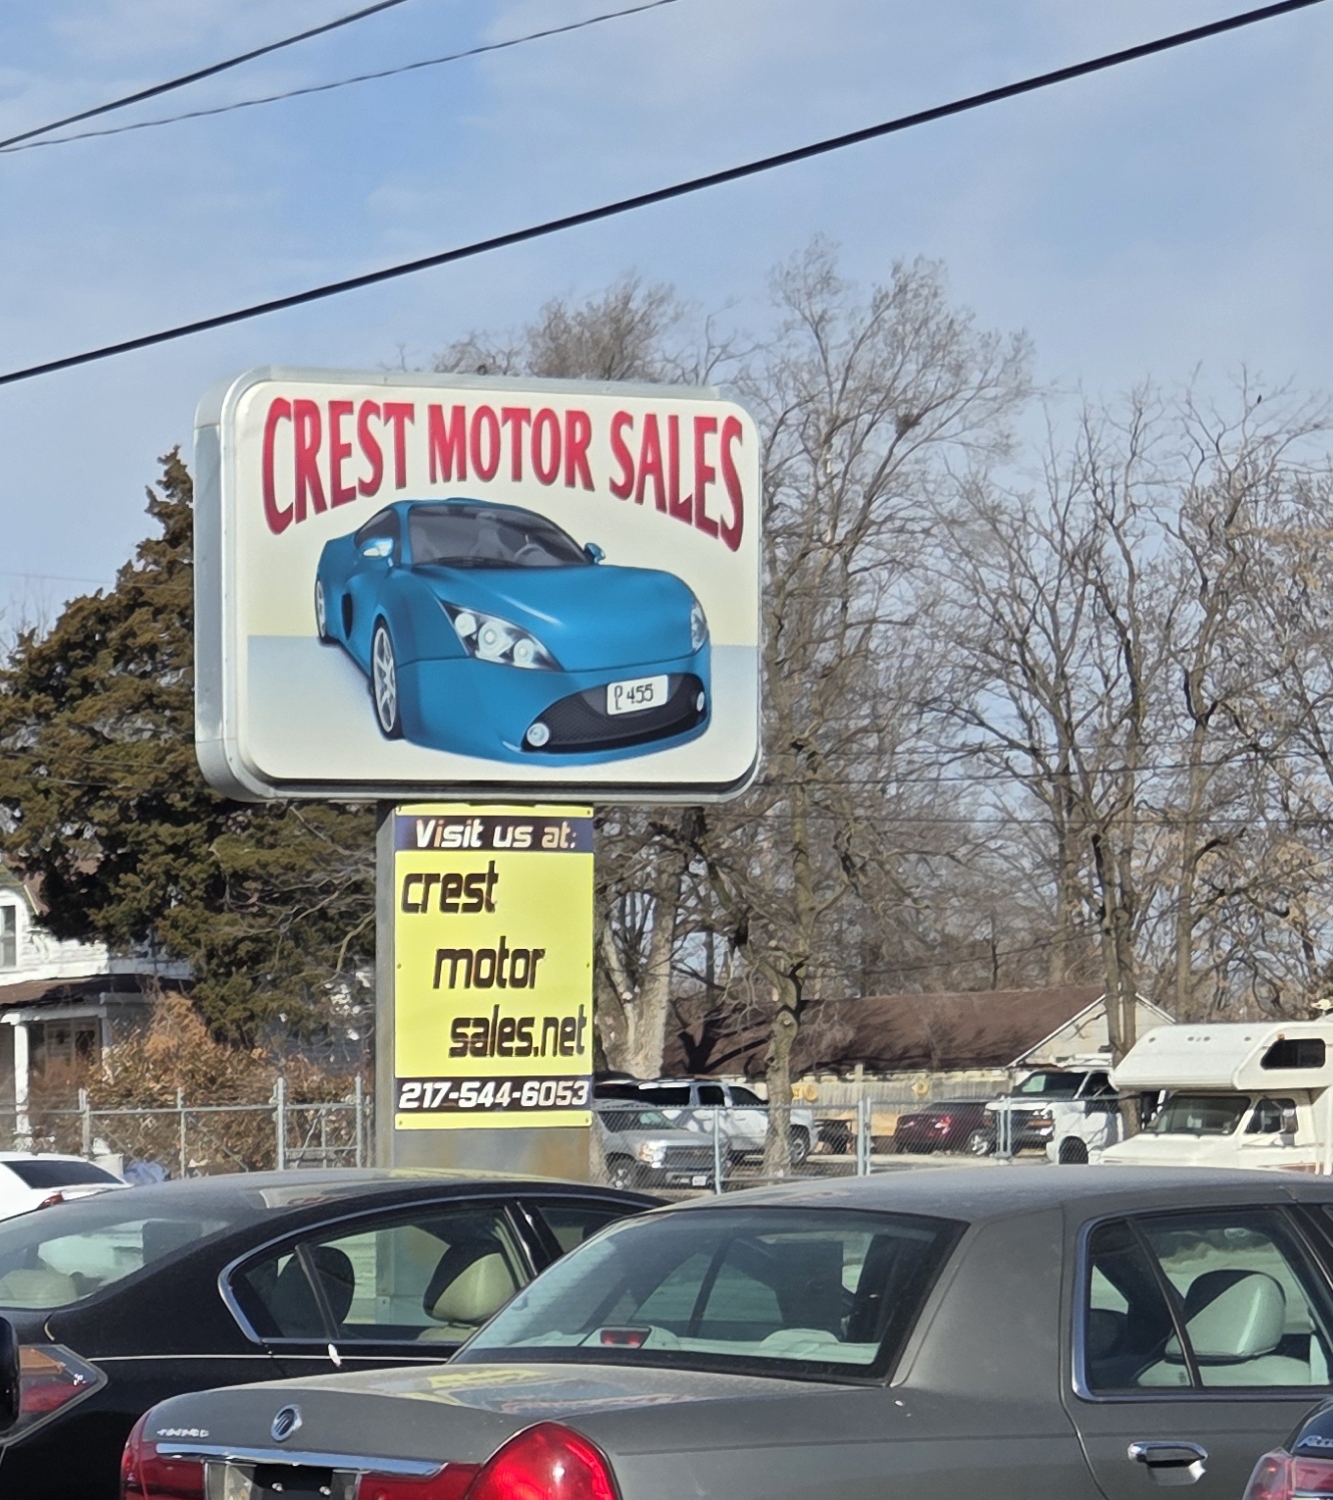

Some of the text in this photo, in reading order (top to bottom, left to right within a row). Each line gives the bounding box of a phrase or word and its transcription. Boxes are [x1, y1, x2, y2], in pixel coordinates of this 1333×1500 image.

[262, 397, 744, 552] CREST MOTOR SALES
[626, 683, 654, 704] 455
[416, 818, 577, 849] Visit us at:
[401, 860, 499, 914] crest
[433, 936, 546, 989] motor
[448, 1004, 587, 1058] sales.net
[399, 1081, 589, 1109] 217-544-6053
